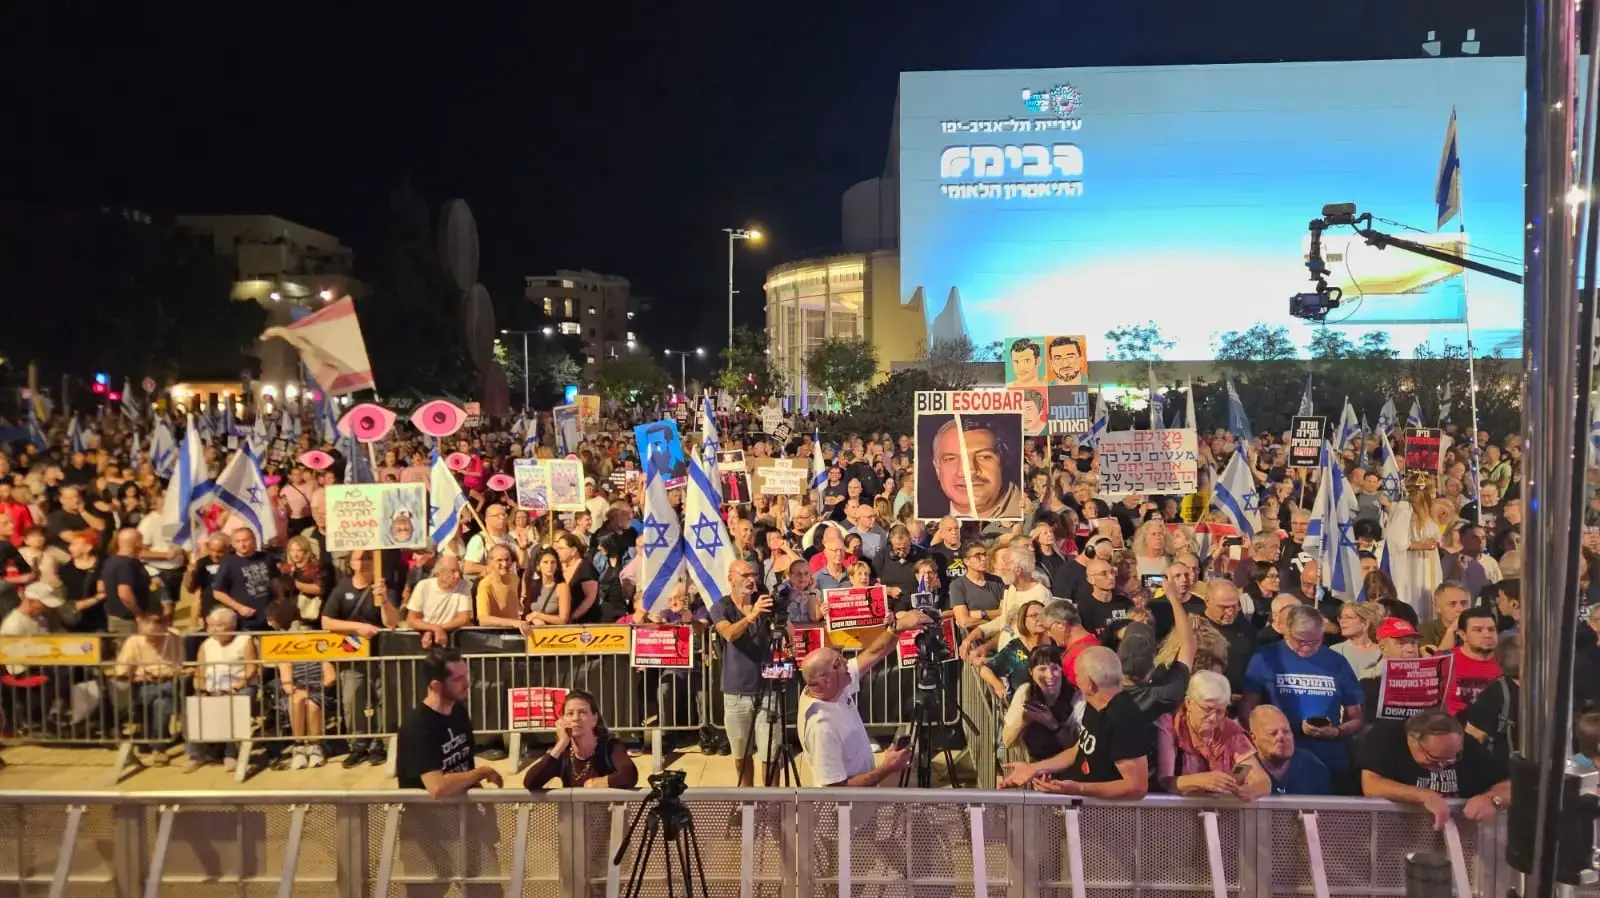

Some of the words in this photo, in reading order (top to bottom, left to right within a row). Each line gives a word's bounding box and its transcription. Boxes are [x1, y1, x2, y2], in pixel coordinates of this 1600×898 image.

[1035, 119, 1082, 132] עיריית
[941, 182, 1001, 199] הלאומי
[1004, 182, 1083, 200] התיאטרון
[918, 392, 947, 411] BIBI
[952, 392, 1022, 411] ESCOBAR
[1072, 391, 1088, 404] עד
[1051, 405, 1088, 419] החטוף
[1048, 418, 1088, 434] האחרון
[1134, 431, 1182, 443] מעולם
[1100, 442, 1155, 452] החריבו
[1162, 440, 1182, 451] לא
[1100, 453, 1119, 467] כך
[1122, 451, 1142, 461] כל
[1149, 451, 1195, 461] מעטים
[1117, 462, 1156, 472] ביתם
[1162, 461, 1181, 471] את
[1101, 471, 1121, 482] של
[1128, 470, 1196, 482] הדמוקרטי
[1101, 483, 1120, 494] כך
[1124, 481, 1144, 492] כל
[1157, 480, 1194, 490] רבים
[1276, 676, 1335, 688] הדמוקרטים
